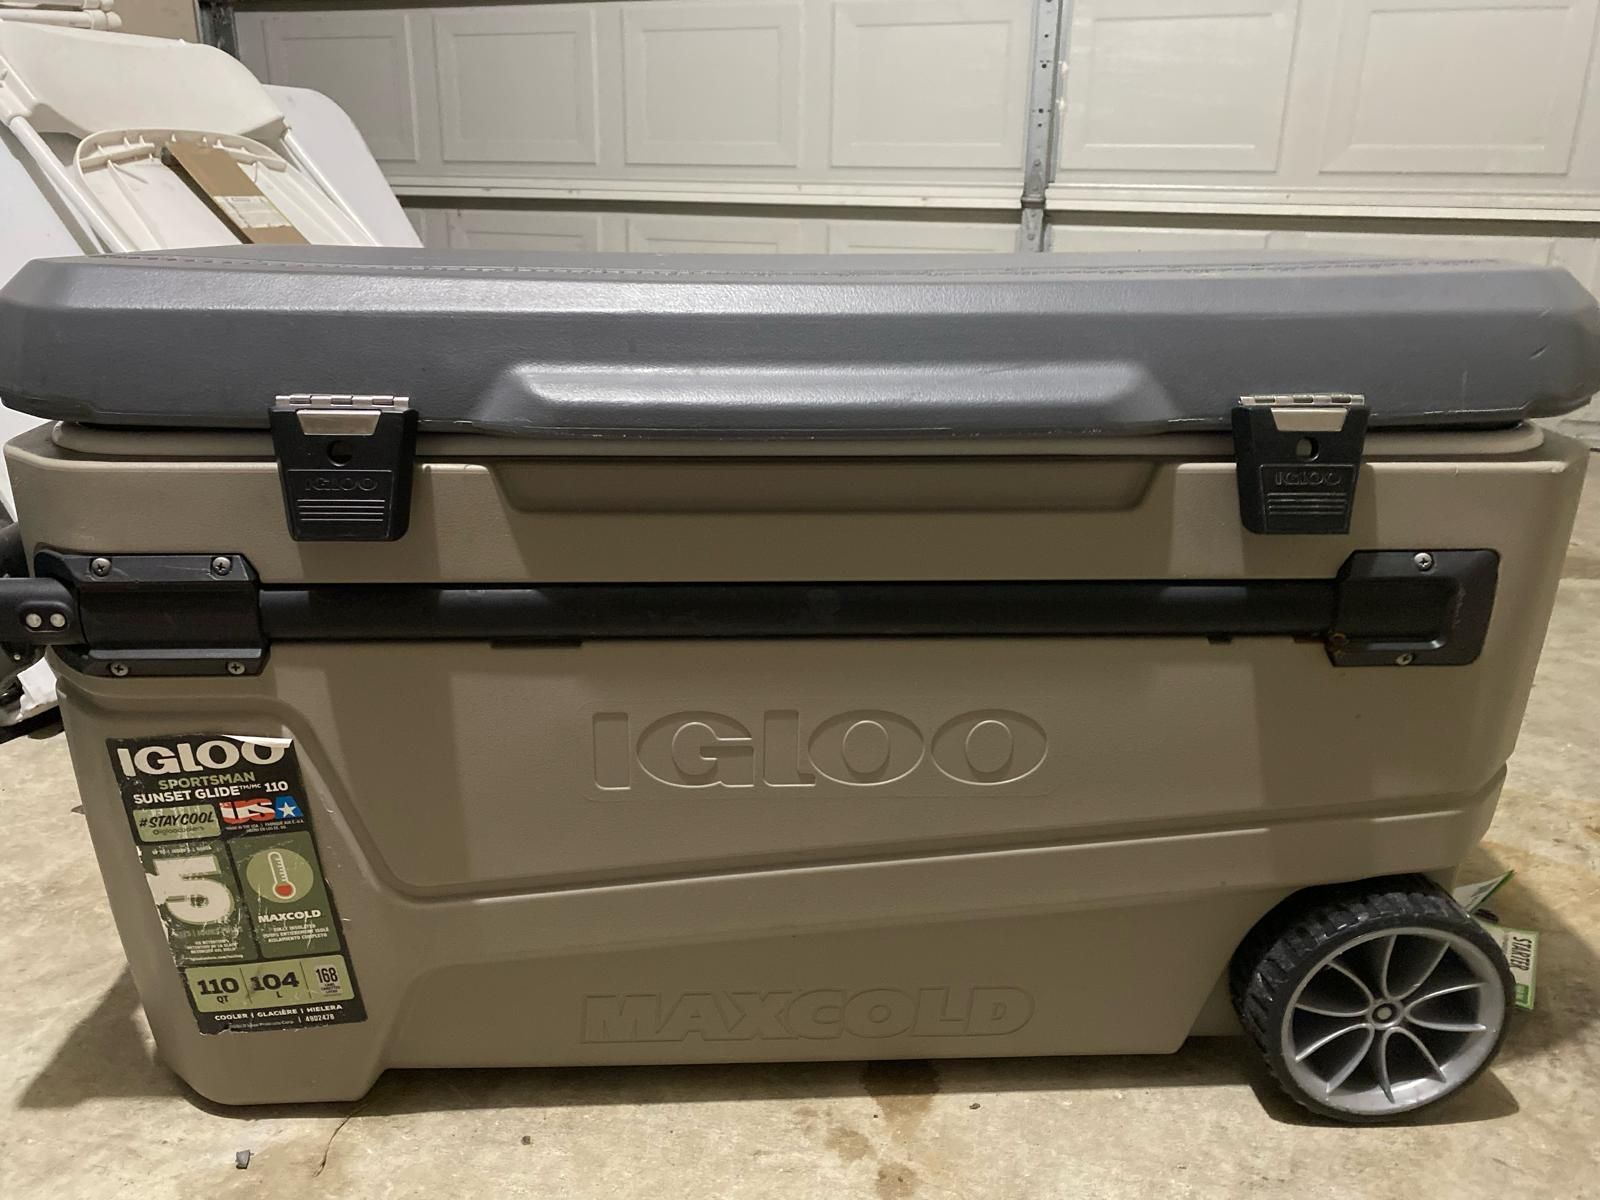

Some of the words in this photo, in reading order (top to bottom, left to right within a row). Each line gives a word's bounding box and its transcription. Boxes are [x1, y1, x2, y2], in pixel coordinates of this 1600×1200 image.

[304, 477, 378, 491] IGLOO
[1274, 471, 1341, 486] IGLOO
[117, 740, 286, 777] IGLOO
[591, 708, 1049, 791] IGLOO
[158, 771, 256, 791] SPORTSMAN
[133, 789, 192, 805] SUNSET
[264, 780, 289, 794] 110
[139, 811, 215, 829] #STAYCOOL
[218, 795, 305, 825] USA
[258, 909, 321, 923] MAXCOLD
[1509, 936, 1532, 971] STARTER
[197, 977, 239, 996] 110
[250, 971, 300, 992] 104
[316, 967, 338, 983] 168
[216, 995, 229, 1005] QT
[214, 1012, 248, 1021] COOLER
[580, 986, 1035, 1044] MAXCOLD
